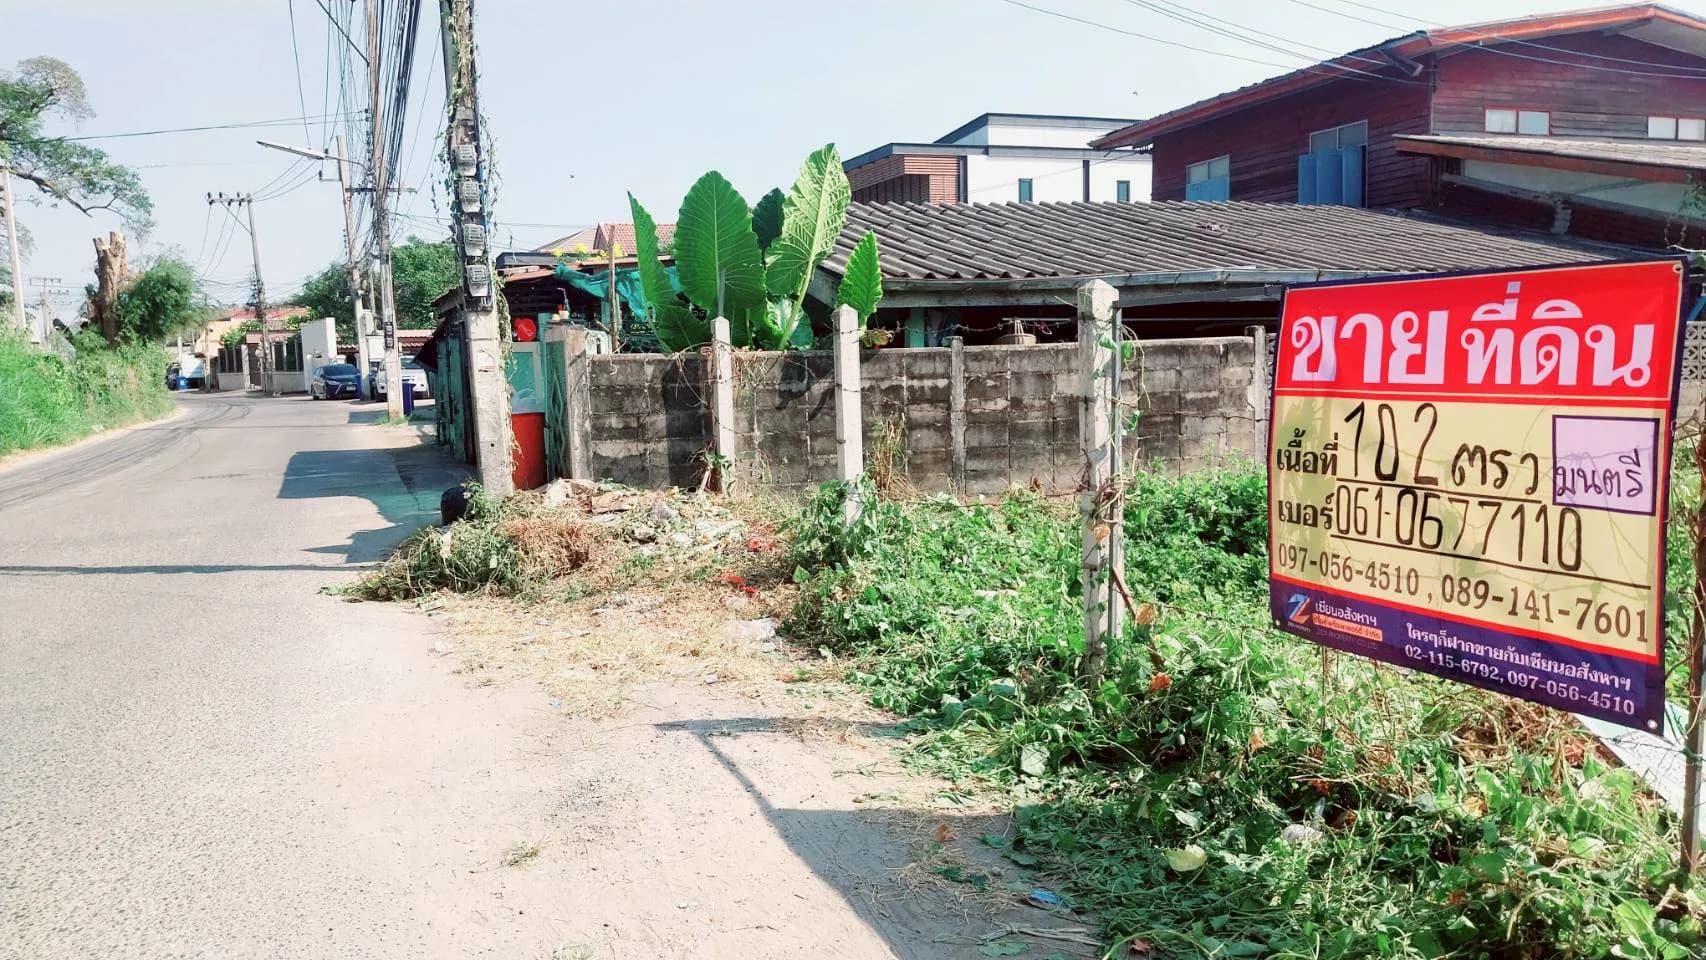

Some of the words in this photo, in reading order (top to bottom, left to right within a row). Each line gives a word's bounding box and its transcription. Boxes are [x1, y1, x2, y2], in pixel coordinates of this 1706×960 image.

[1291, 309, 1450, 385] ขาย
[1461, 280, 1655, 388] ที่ดิน
[1276, 428, 1339, 476] เนื้อที่
[1344, 401, 1439, 485] 102
[1555, 448, 1644, 498] มนตรี
[1278, 492, 1335, 530] เบอร์
[1336, 485, 1583, 572] 061-0677110
[1278, 543, 1420, 597] 097-056-4510
[1441, 574, 1649, 643] 089-141-7601
[1405, 644, 1503, 684] 02-115-6792,
[1507, 670, 1635, 716] 097-056-4510
